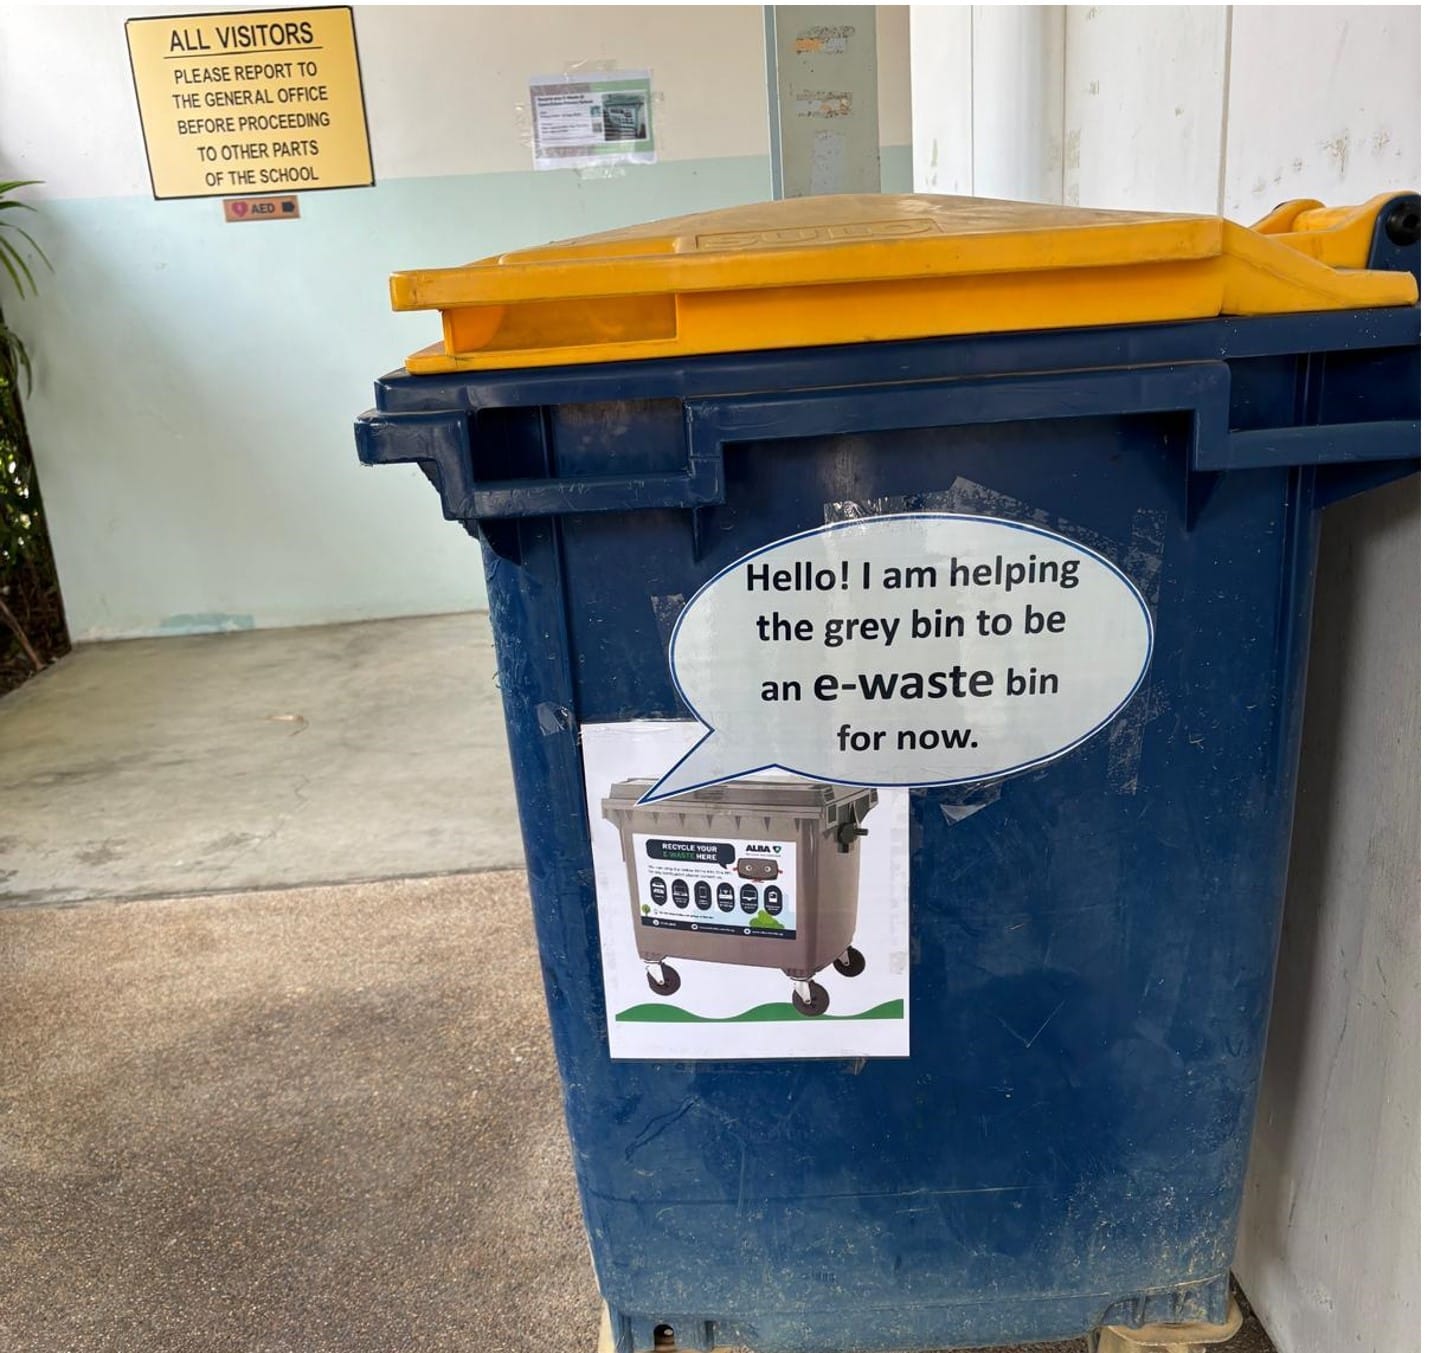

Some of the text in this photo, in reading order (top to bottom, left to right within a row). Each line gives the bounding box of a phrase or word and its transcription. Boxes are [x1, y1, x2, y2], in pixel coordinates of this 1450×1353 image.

[169, 22, 314, 52] ALL VISITORS
[174, 61, 317, 85] PLEASE REPORT TO
[172, 86, 328, 109] THE GENERAL OFFICE
[178, 112, 330, 135] BEFORE PROCEEDING
[197, 140, 319, 162] TO OTHER PARTS
[205, 166, 319, 187] OF THE SCHOOL
[251, 202, 275, 214] AED
[746, 555, 1081, 593] Hello! I am helping
[756, 604, 1066, 648] the grey bin to be
[760, 665, 1059, 702] an e-waste bin
[837, 724, 979, 751] for now.
[662, 843, 695, 852] RECYCLE
[746, 845, 771, 853] ALBA
